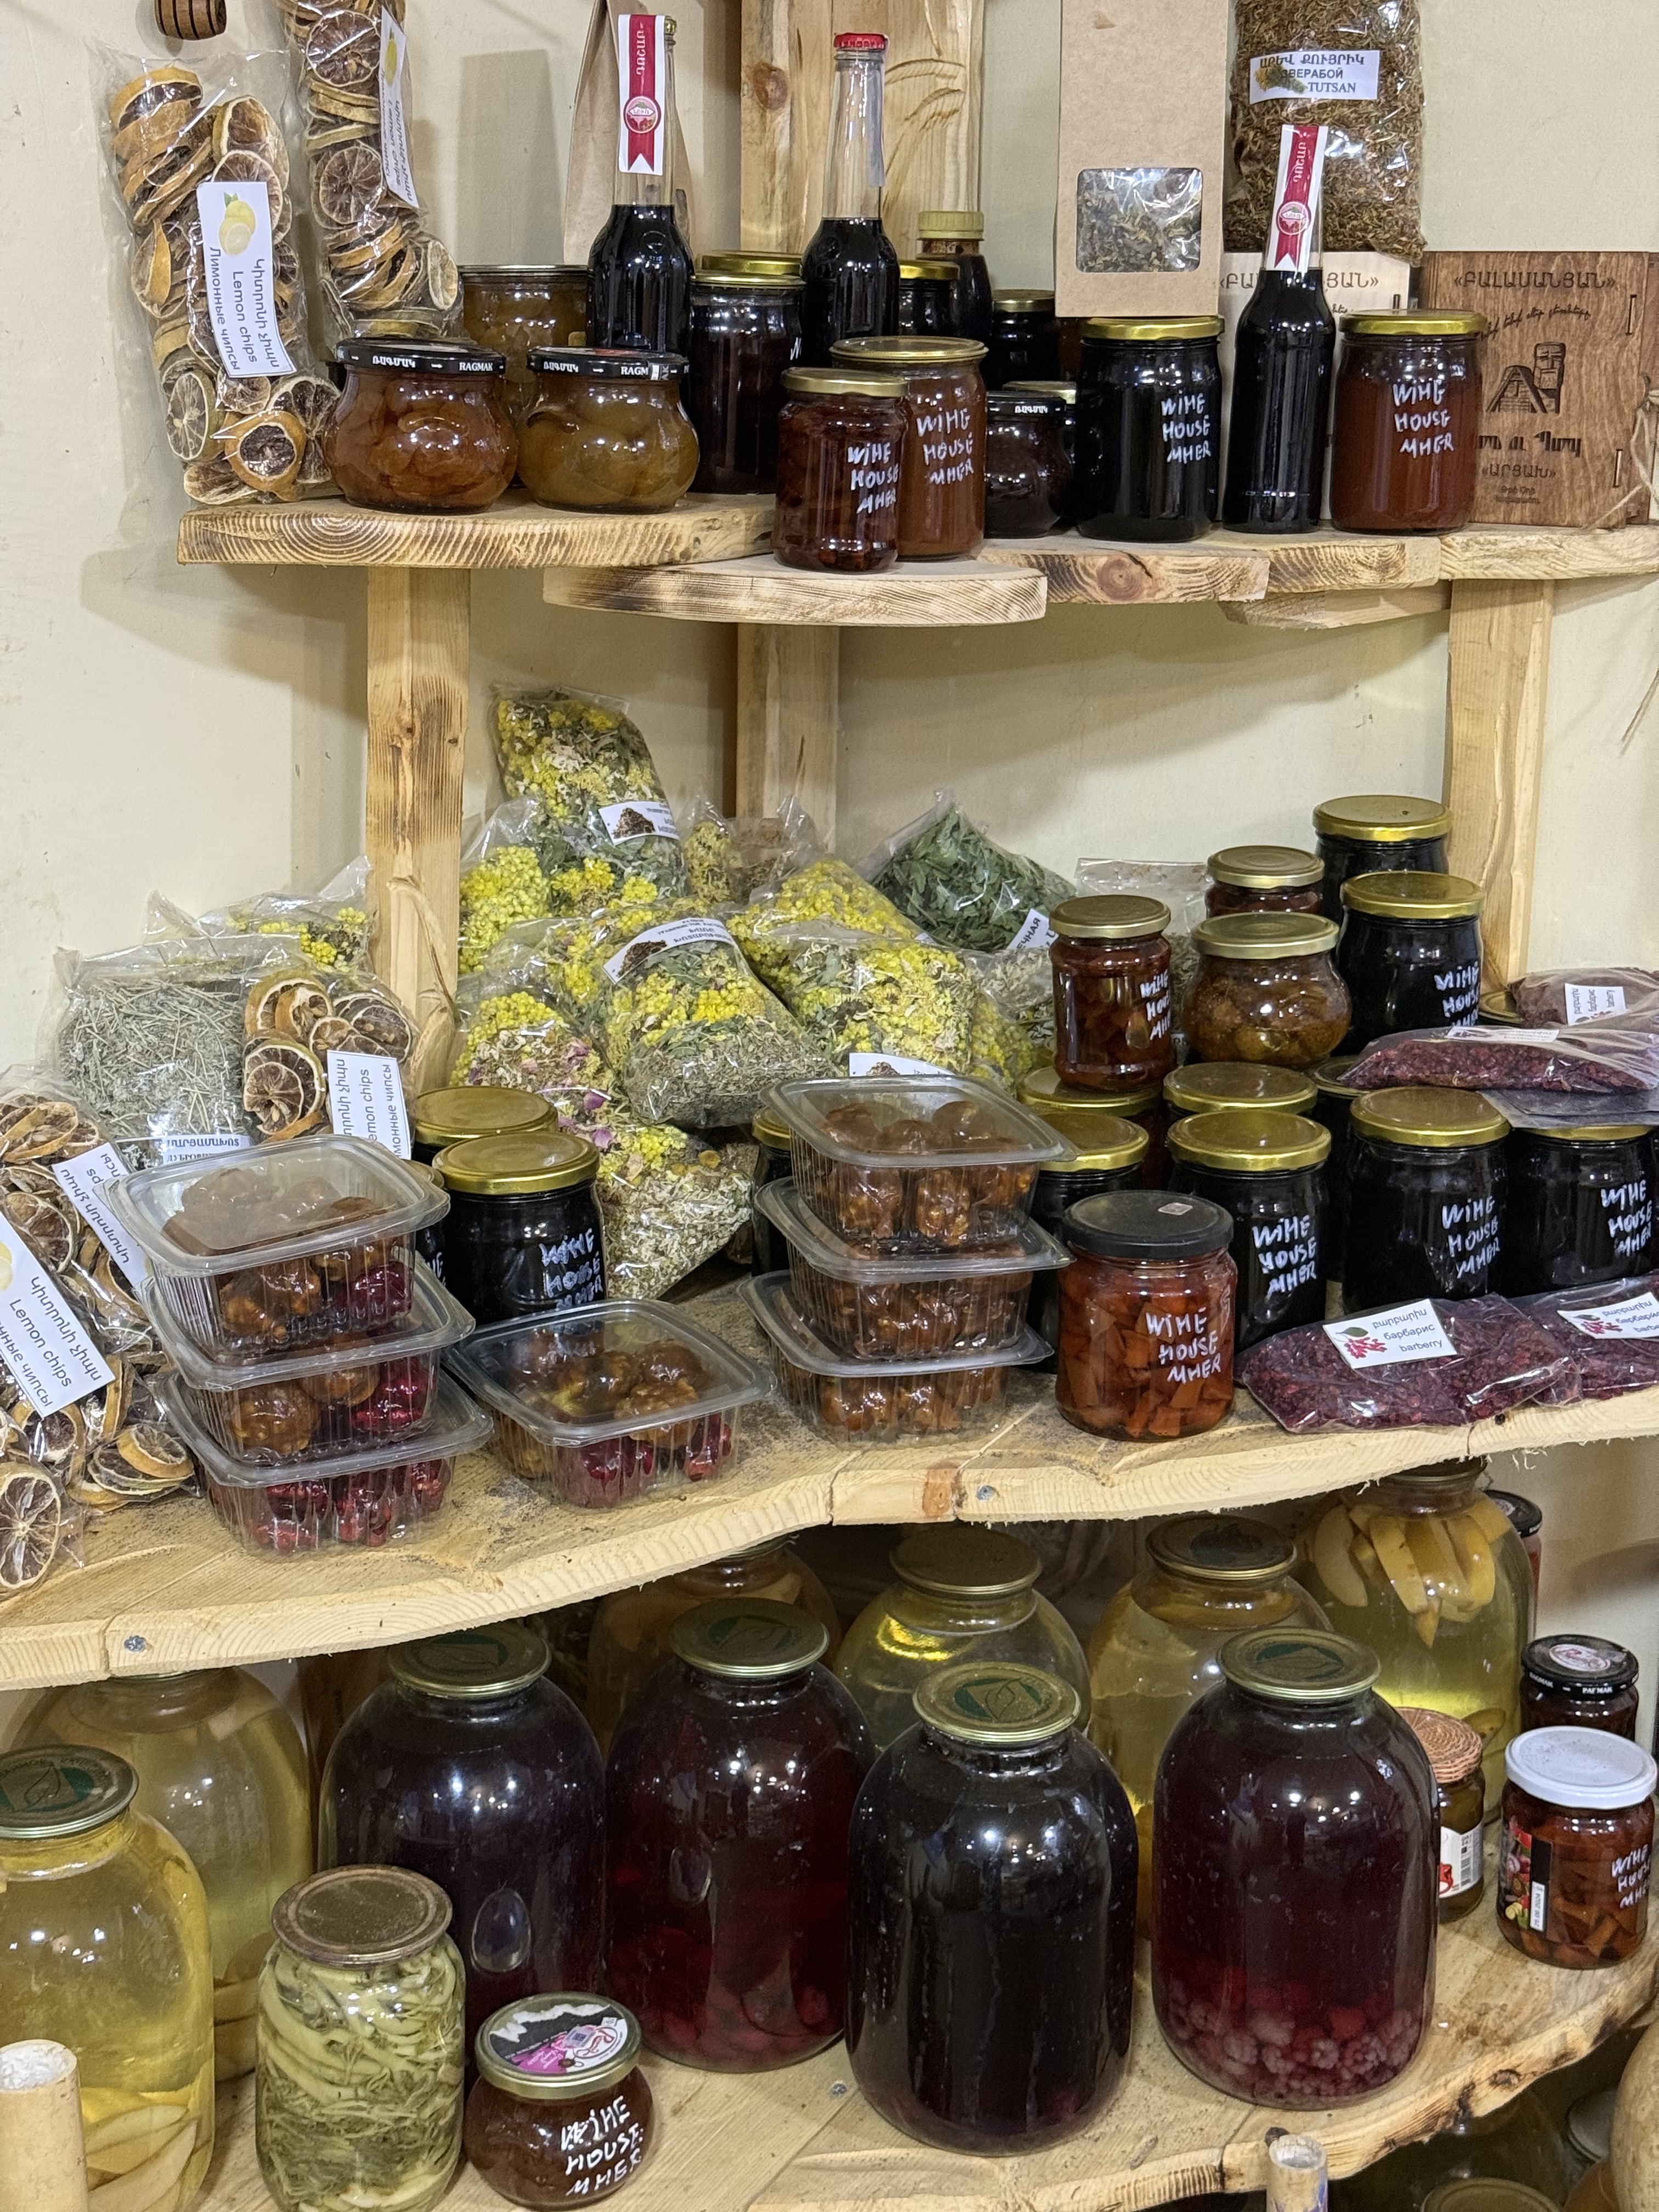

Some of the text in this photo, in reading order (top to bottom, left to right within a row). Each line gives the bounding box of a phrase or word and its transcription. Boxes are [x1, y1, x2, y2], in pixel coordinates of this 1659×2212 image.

[1308, 82, 1356, 93] TUTSAN
[210, 247, 241, 370] Лимонные чипсы
[251, 258, 269, 329] Կիտրոնի
[232, 271, 258, 363] Lemon chips
[459, 362, 494, 373] RAGMAK
[1163, 415, 1210, 443] HOUSE
[359, 1069, 378, 1142] emon chips
[382, 1064, 402, 1156] монные чипсы
[9, 1298, 74, 1388] Lemon chips
[30, 1276, 103, 1382] Կիտրոնի չիպս
[1158, 1329, 1218, 1364] HOUSE
[1383, 1324, 1436, 1341] барбарис
[1399, 1338, 1443, 1353] barberry
[20, 1362, 54, 1408] чипсы
[1166, 1355, 1222, 1385] MHER
[564, 2125, 645, 2176] HOUSE
[565, 2151, 643, 2196] MHER
